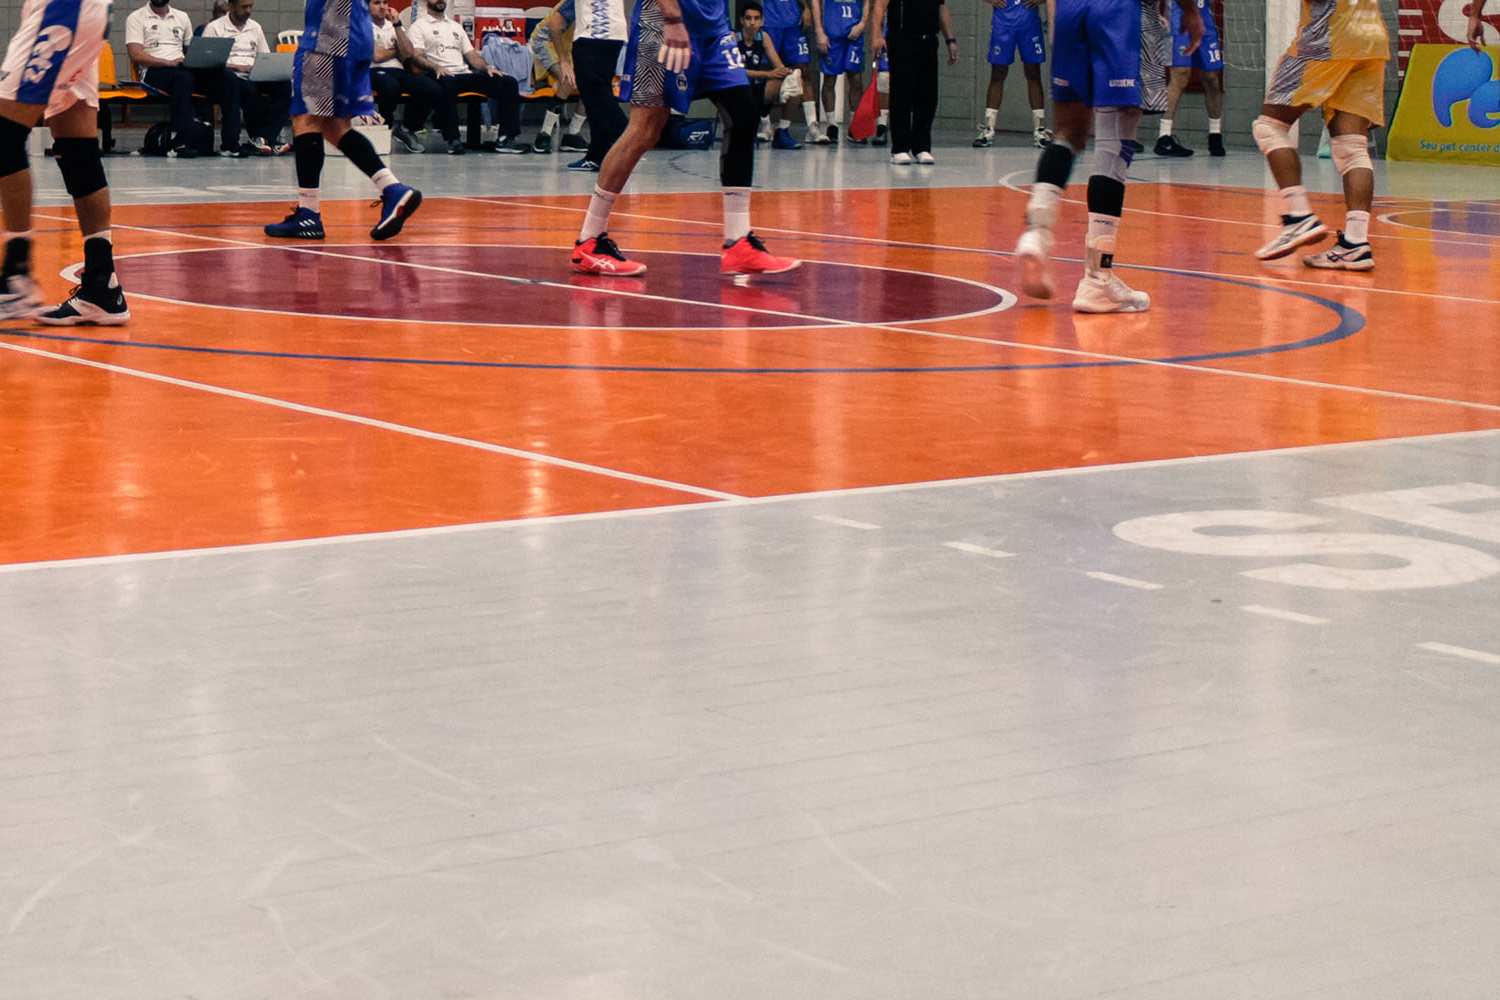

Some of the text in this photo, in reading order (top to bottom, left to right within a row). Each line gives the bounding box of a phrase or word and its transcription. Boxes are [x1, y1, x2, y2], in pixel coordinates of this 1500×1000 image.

[841, 5, 853, 18] 11
[1420, 138, 1438, 151] Seu
[1458, 143, 1491, 153] center
